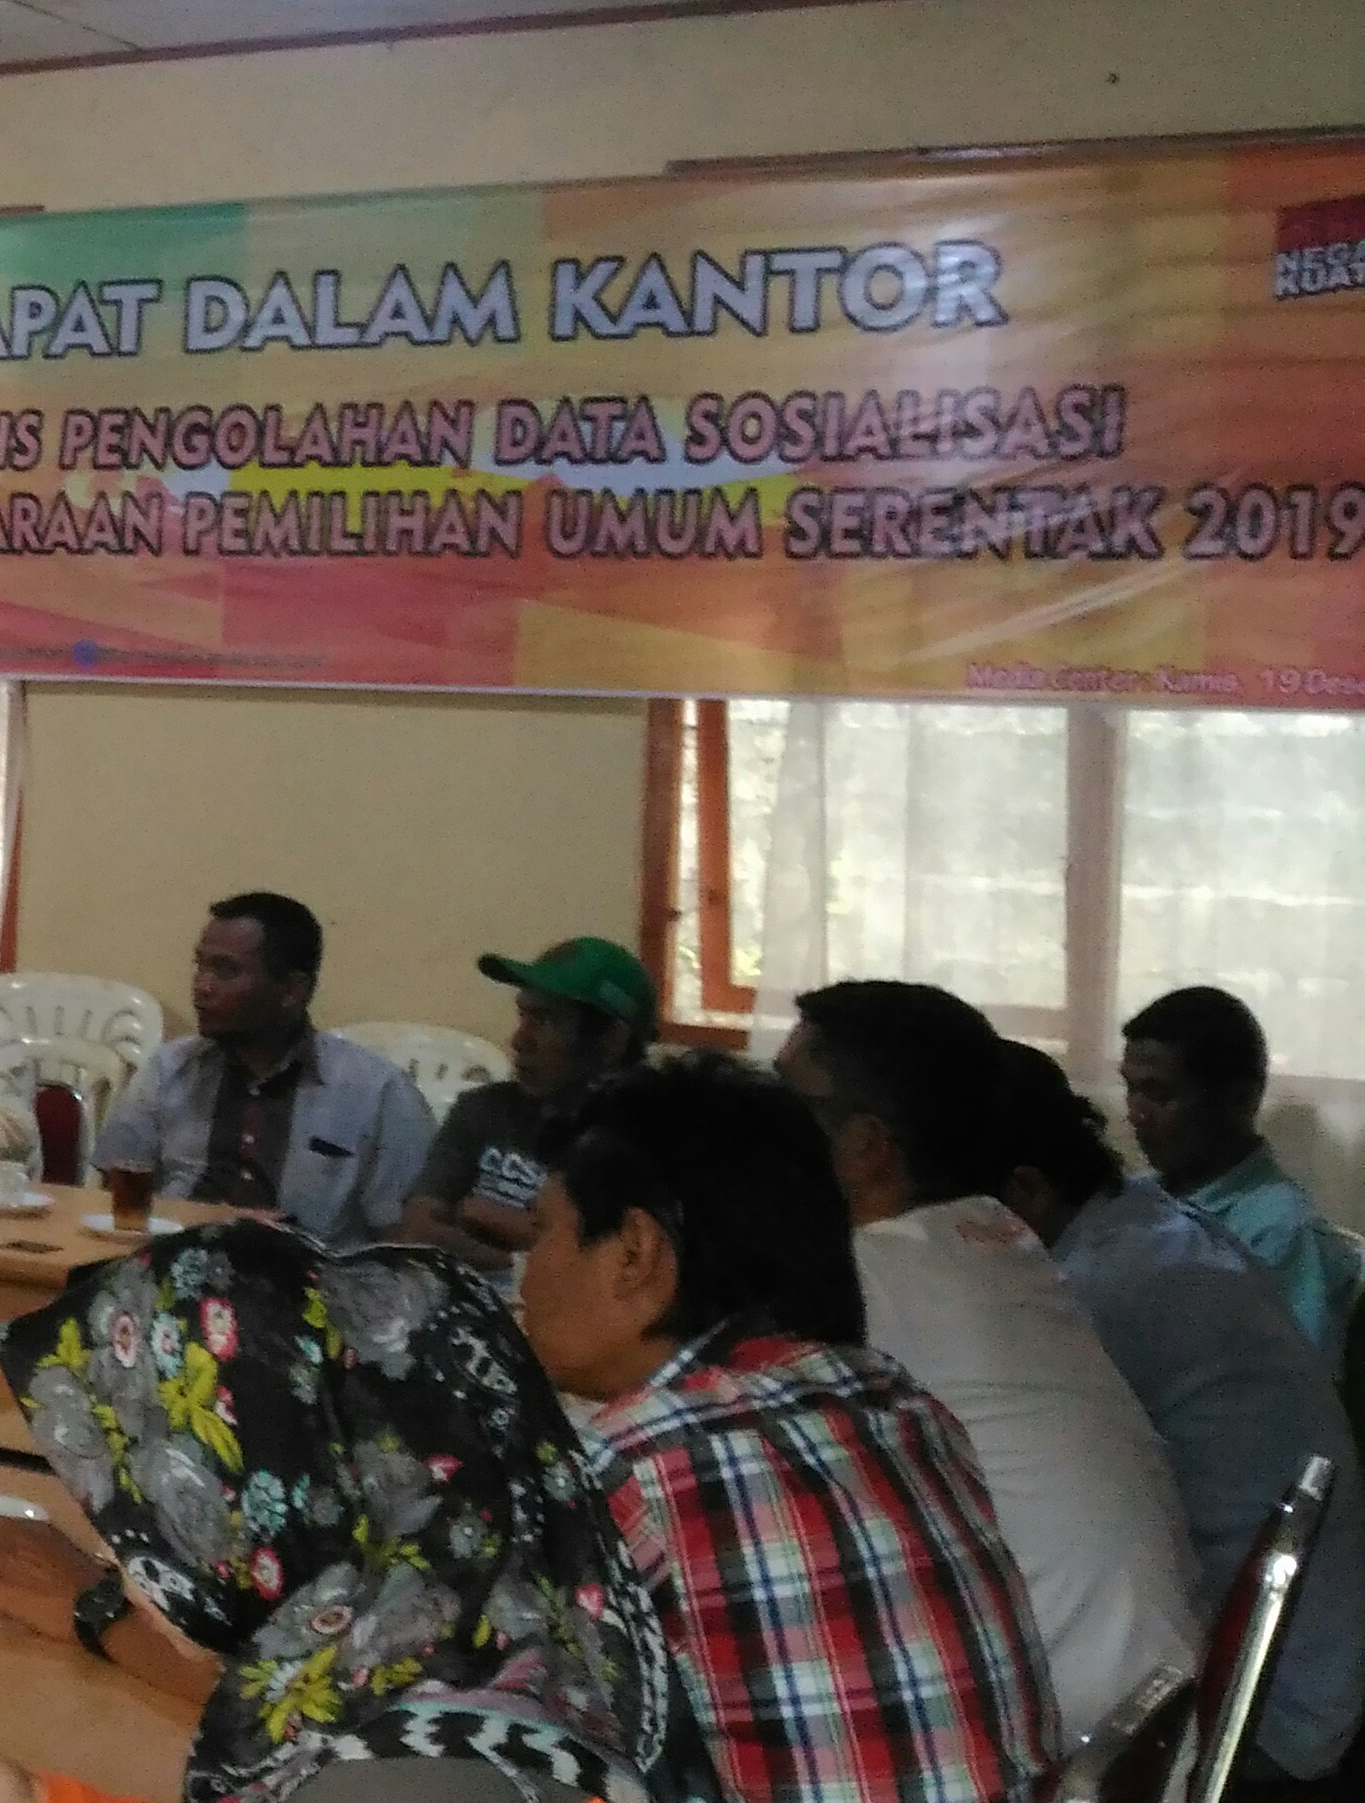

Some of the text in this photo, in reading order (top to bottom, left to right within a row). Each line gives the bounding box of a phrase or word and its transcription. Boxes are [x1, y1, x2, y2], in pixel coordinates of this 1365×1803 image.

[183, 260, 521, 354] DALAM
[550, 239, 1010, 341] KANTOR
[58, 400, 474, 472] PENGOLAHAN
[491, 396, 667, 467] DATA
[683, 385, 1126, 465] SOSIALISASI
[182, 488, 523, 558] PEMILIHAN
[545, 486, 765, 558] UMUM
[783, 484, 1165, 562] SERENTAK
[1181, 482, 1365, 562] 2019
[1259, 668, 1300, 695] 19
